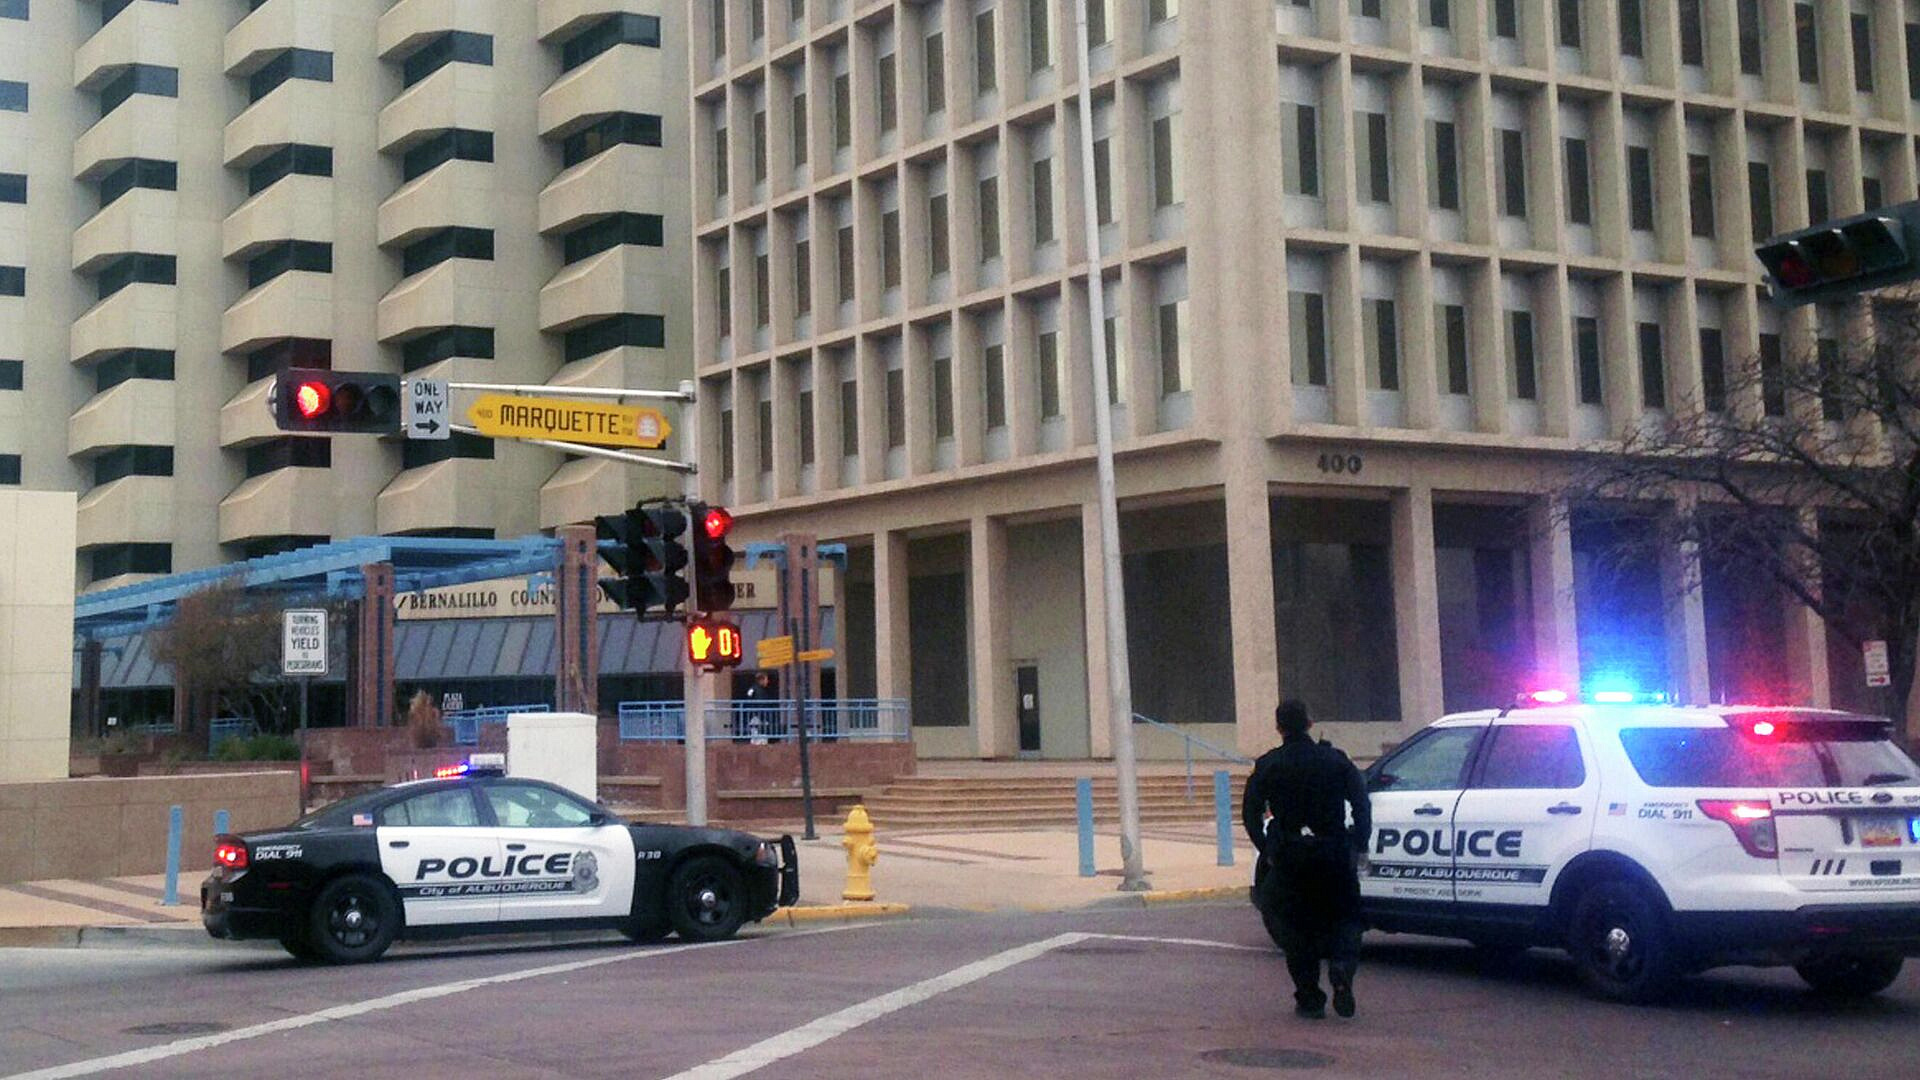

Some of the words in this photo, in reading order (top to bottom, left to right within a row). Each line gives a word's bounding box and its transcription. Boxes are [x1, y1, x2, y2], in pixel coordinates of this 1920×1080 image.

[414, 382, 440, 397] ONE
[414, 400, 443, 415] WAY
[500, 404, 620, 436] MARQUETTE
[1317, 453, 1363, 474] 400
[410, 591, 498, 610] BERNALILLO
[291, 637, 320, 650] YIELD
[1778, 791, 1864, 805] POLICE
[1638, 808, 1667, 819] DIAL
[1672, 808, 1693, 819] 911
[1375, 828, 1524, 858] POLICE
[255, 851, 282, 861] DIAL
[285, 849, 303, 859] 911
[415, 852, 572, 881] POLICE
[1378, 866, 1401, 879] City
[1404, 867, 1416, 877] of
[1418, 869, 1520, 881] ALBUQUERQUE
[419, 885, 444, 896] City
[448, 885, 462, 895] of
[465, 881, 566, 894] ALBUQUERQUE
